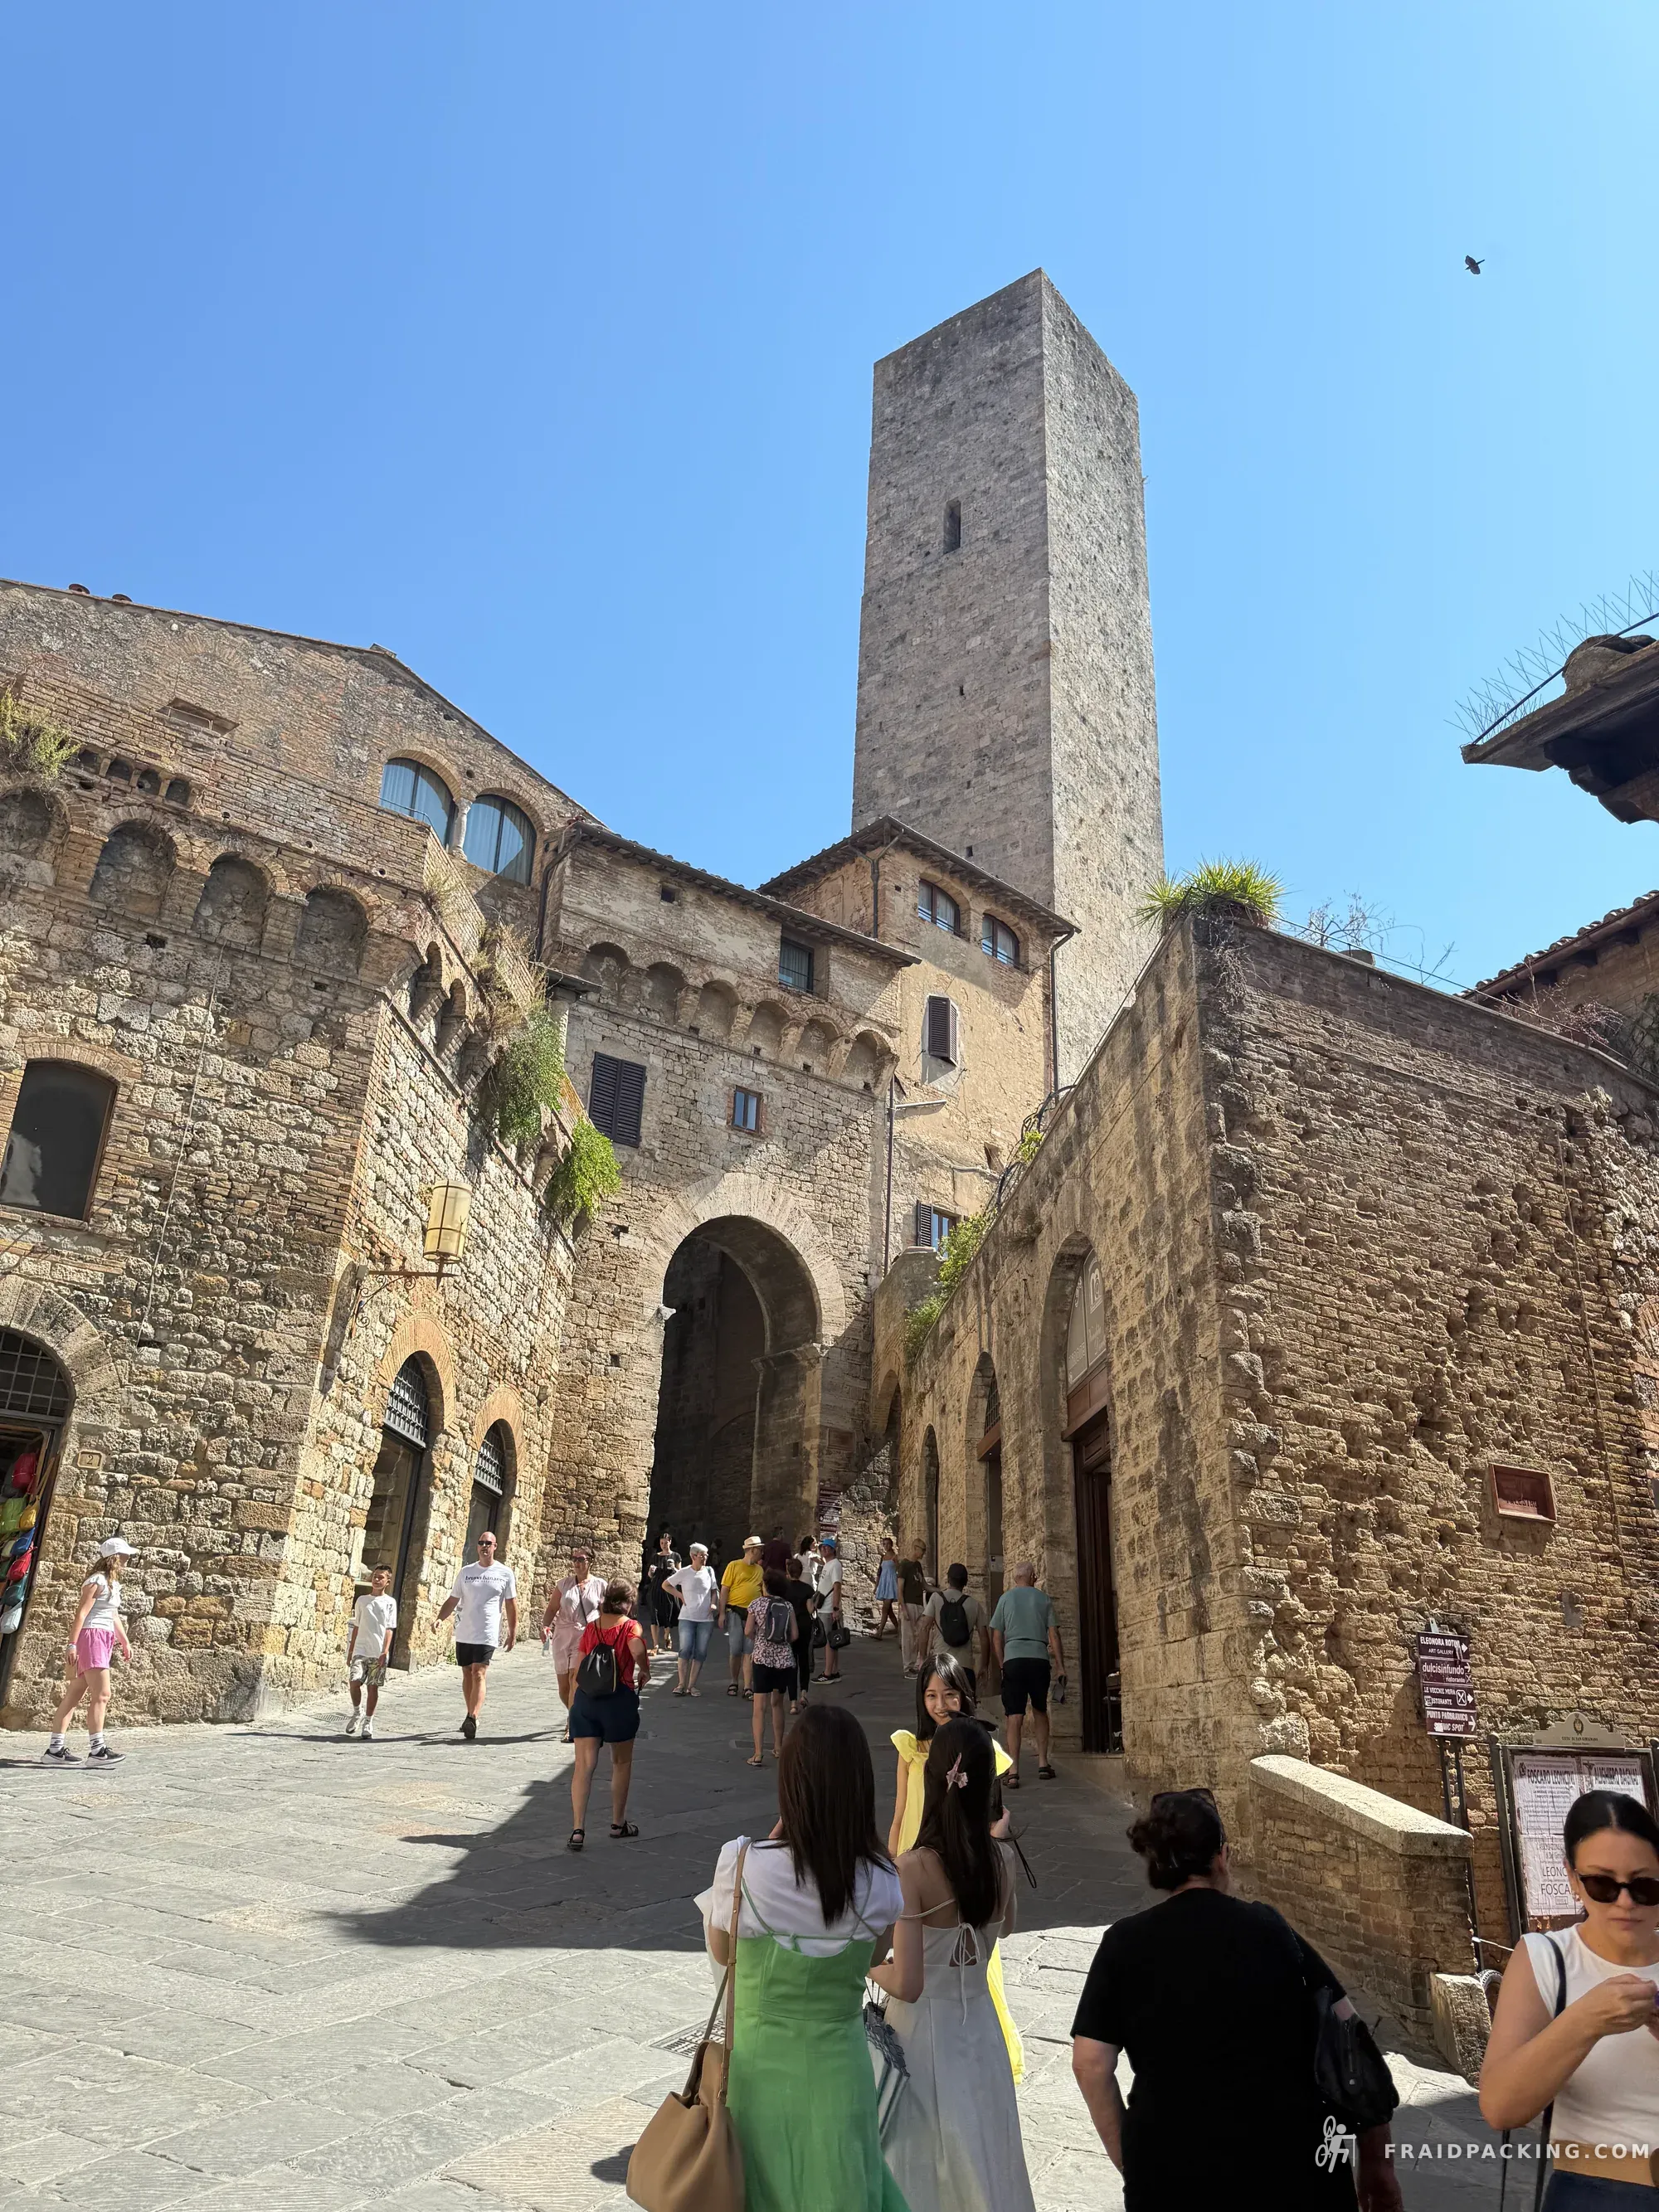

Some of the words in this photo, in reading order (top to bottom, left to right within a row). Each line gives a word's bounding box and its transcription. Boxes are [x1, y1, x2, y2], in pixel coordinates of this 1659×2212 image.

[86, 1454, 94, 1465] 2
[1420, 1636, 1444, 1646] ELEONORA
[1422, 1662, 1464, 1675] dulcisinfundo
[1427, 1710, 1441, 1719] PUNTO
[1442, 1711, 1468, 1721] PANORAMICO
[1452, 1723, 1464, 1732] SPOT
[1527, 1769, 1551, 1784] FOSCARO
